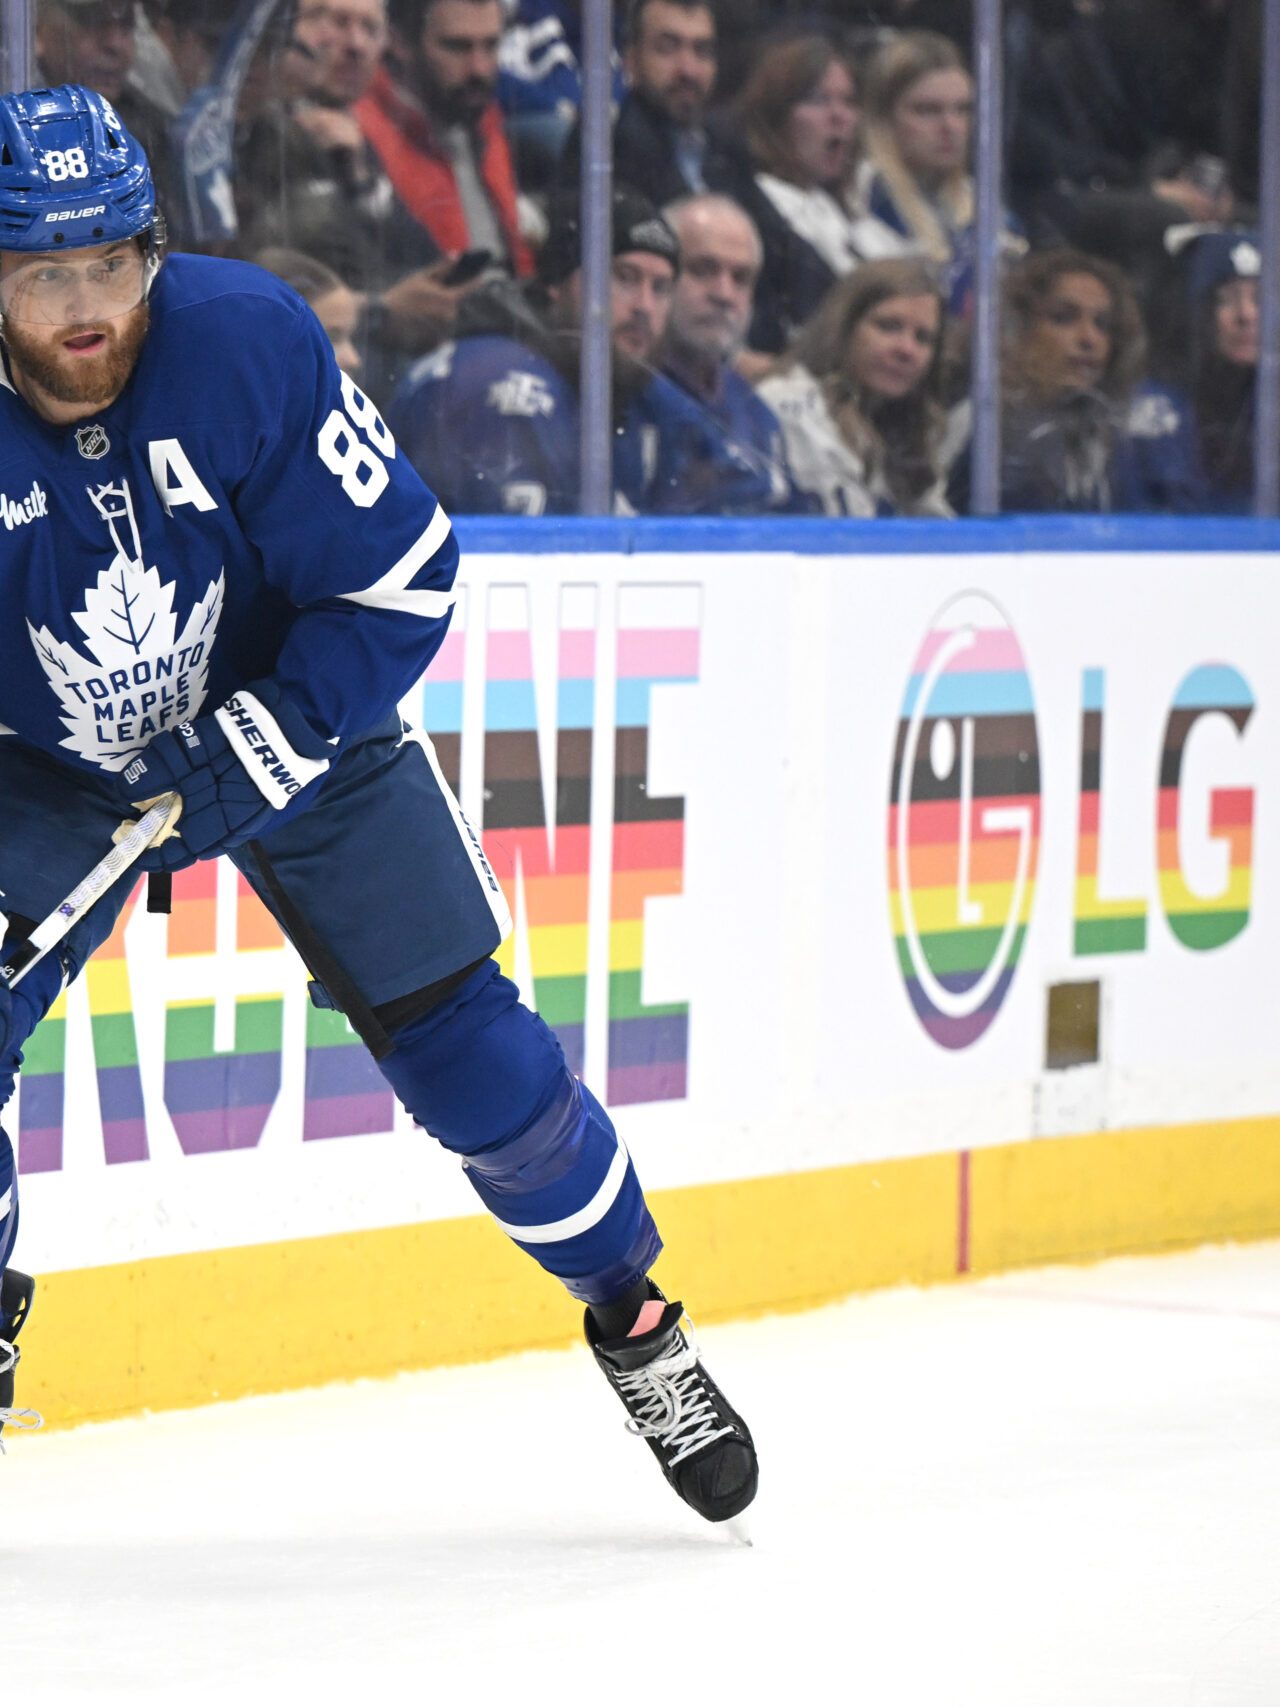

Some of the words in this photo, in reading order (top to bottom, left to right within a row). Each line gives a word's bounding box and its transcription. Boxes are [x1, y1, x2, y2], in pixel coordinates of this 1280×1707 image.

[43, 148, 89, 181] 88
[45, 205, 106, 222] BAUER
[148, 438, 218, 518] A
[64, 641, 205, 704] TORONTO
[94, 672, 190, 721] MAPLE
[96, 693, 190, 743] LEAFS
[1073, 660, 1257, 958] LG
